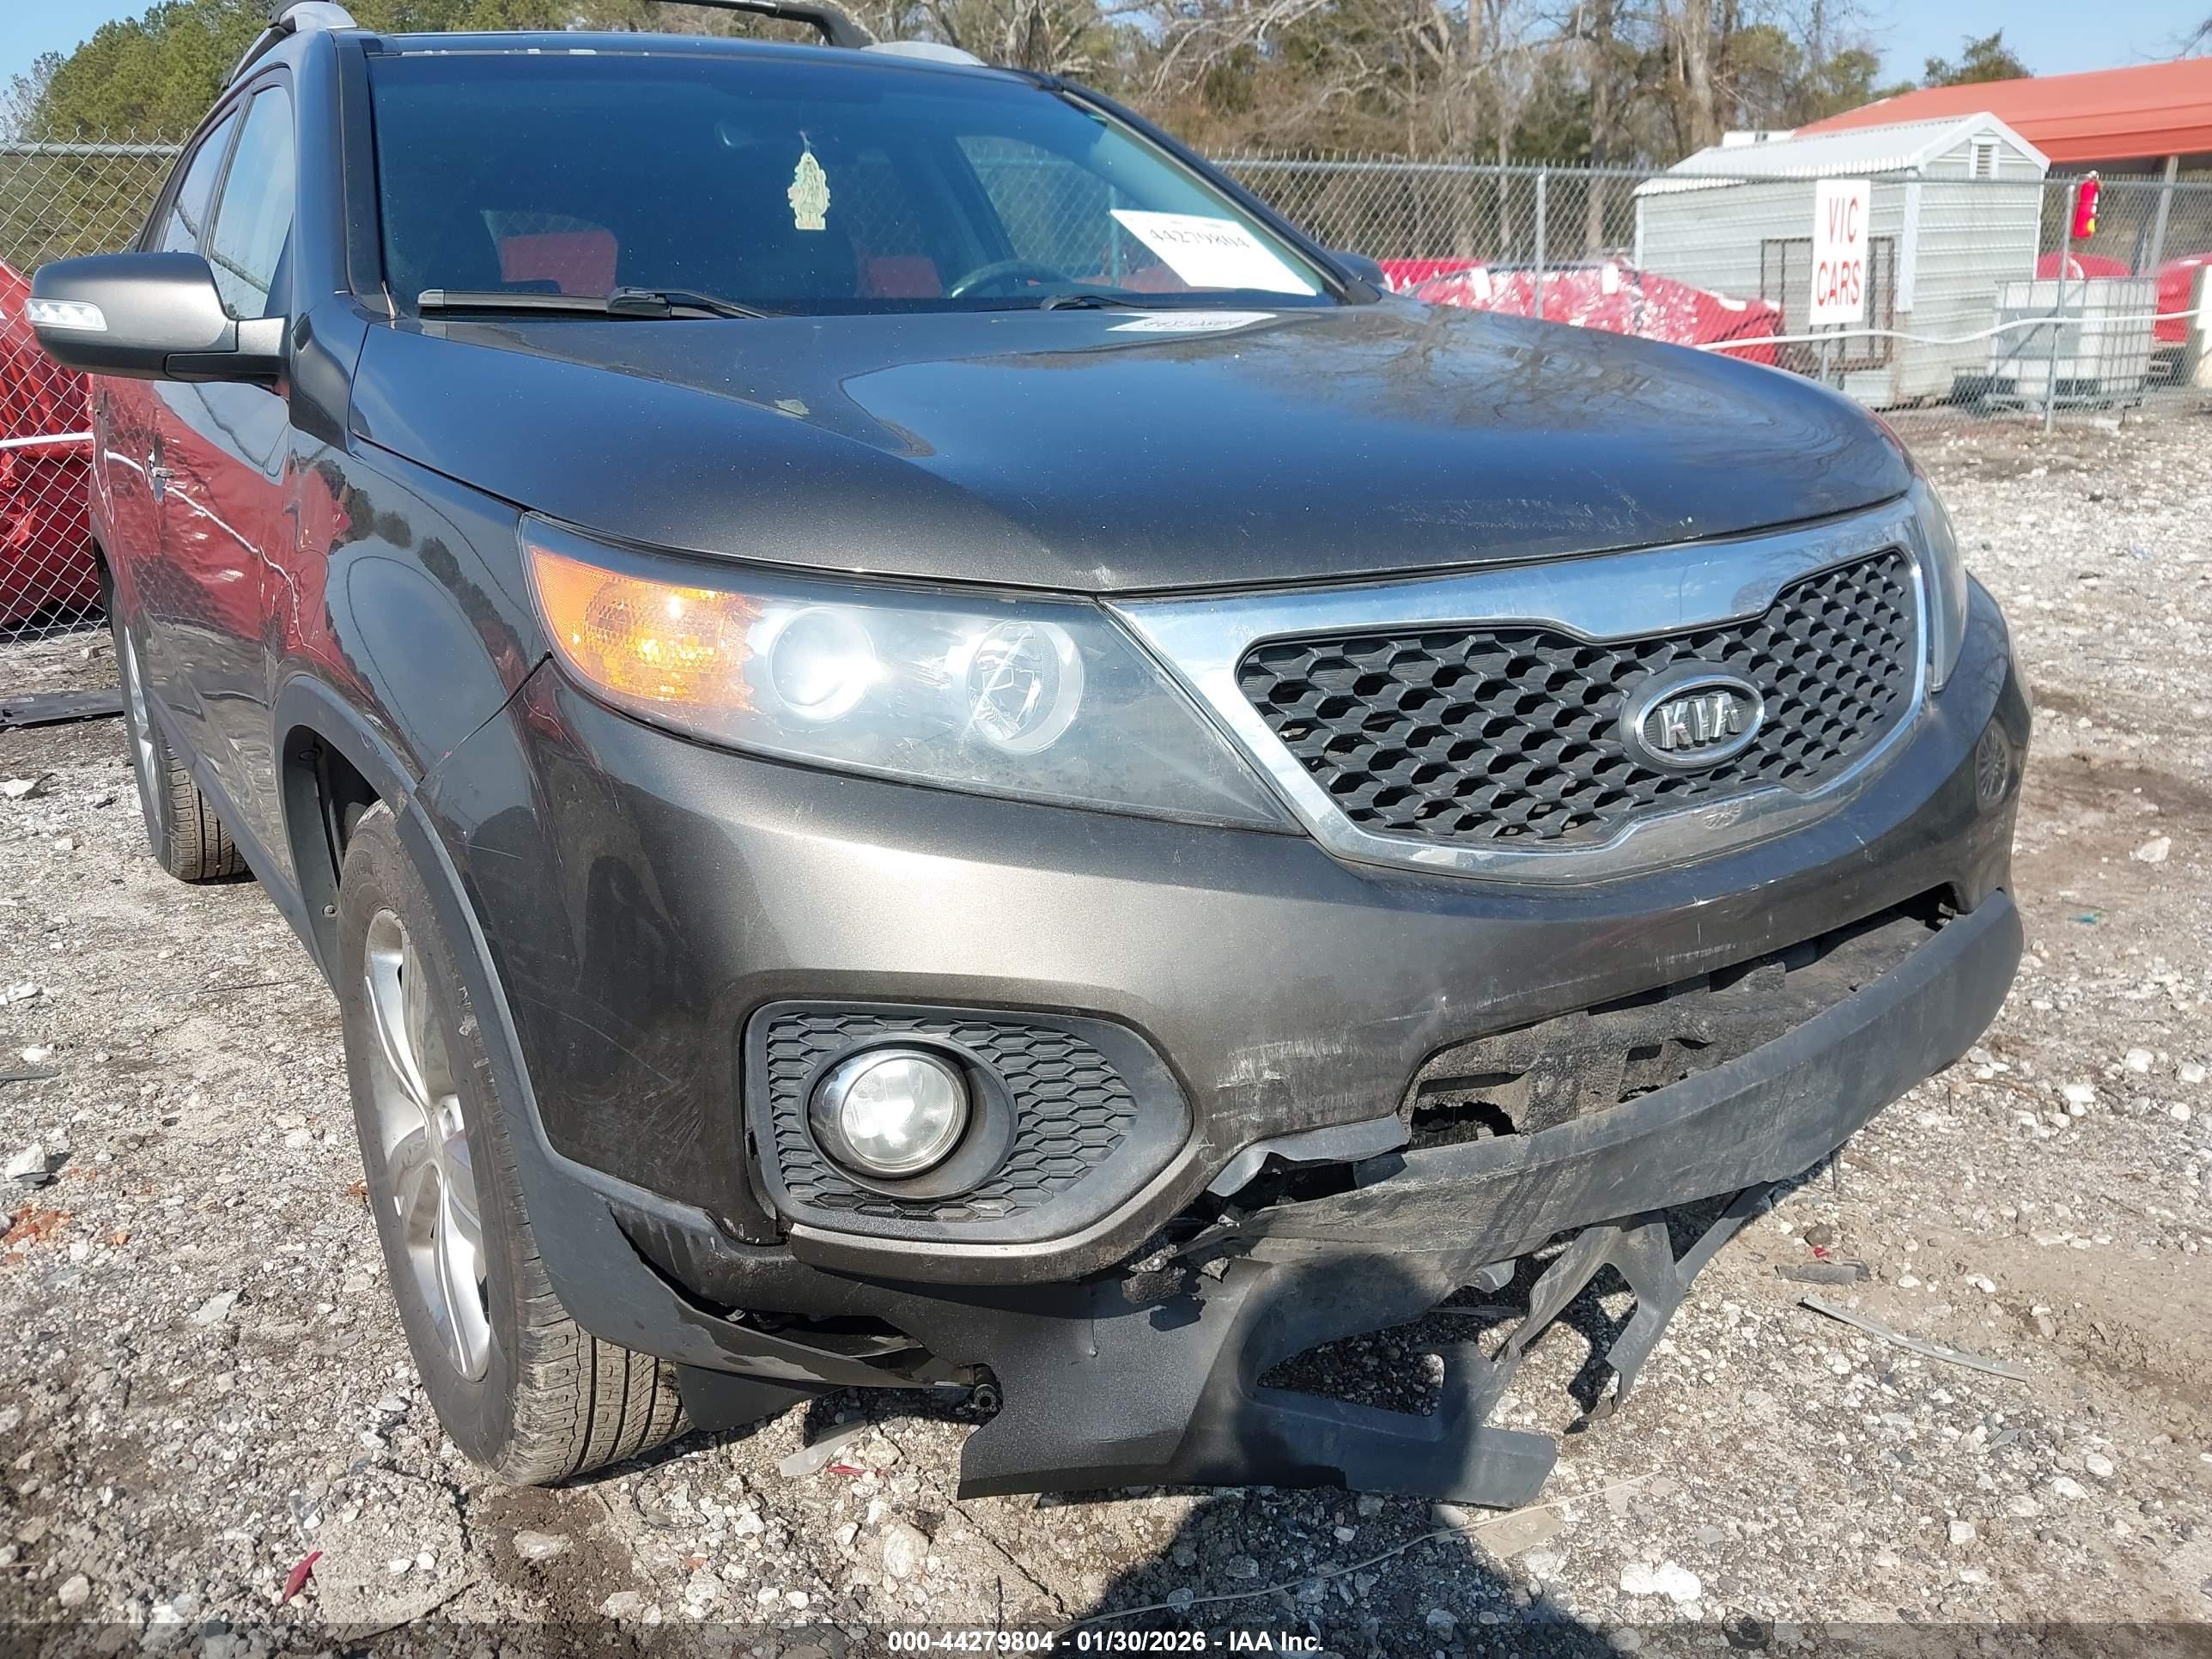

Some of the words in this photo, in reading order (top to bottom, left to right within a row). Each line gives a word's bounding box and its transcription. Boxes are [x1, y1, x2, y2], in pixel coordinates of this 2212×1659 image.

[1828, 197, 1859, 245] VIC
[1816, 259, 1862, 307] CARS
[1655, 690, 1741, 751] KIA
